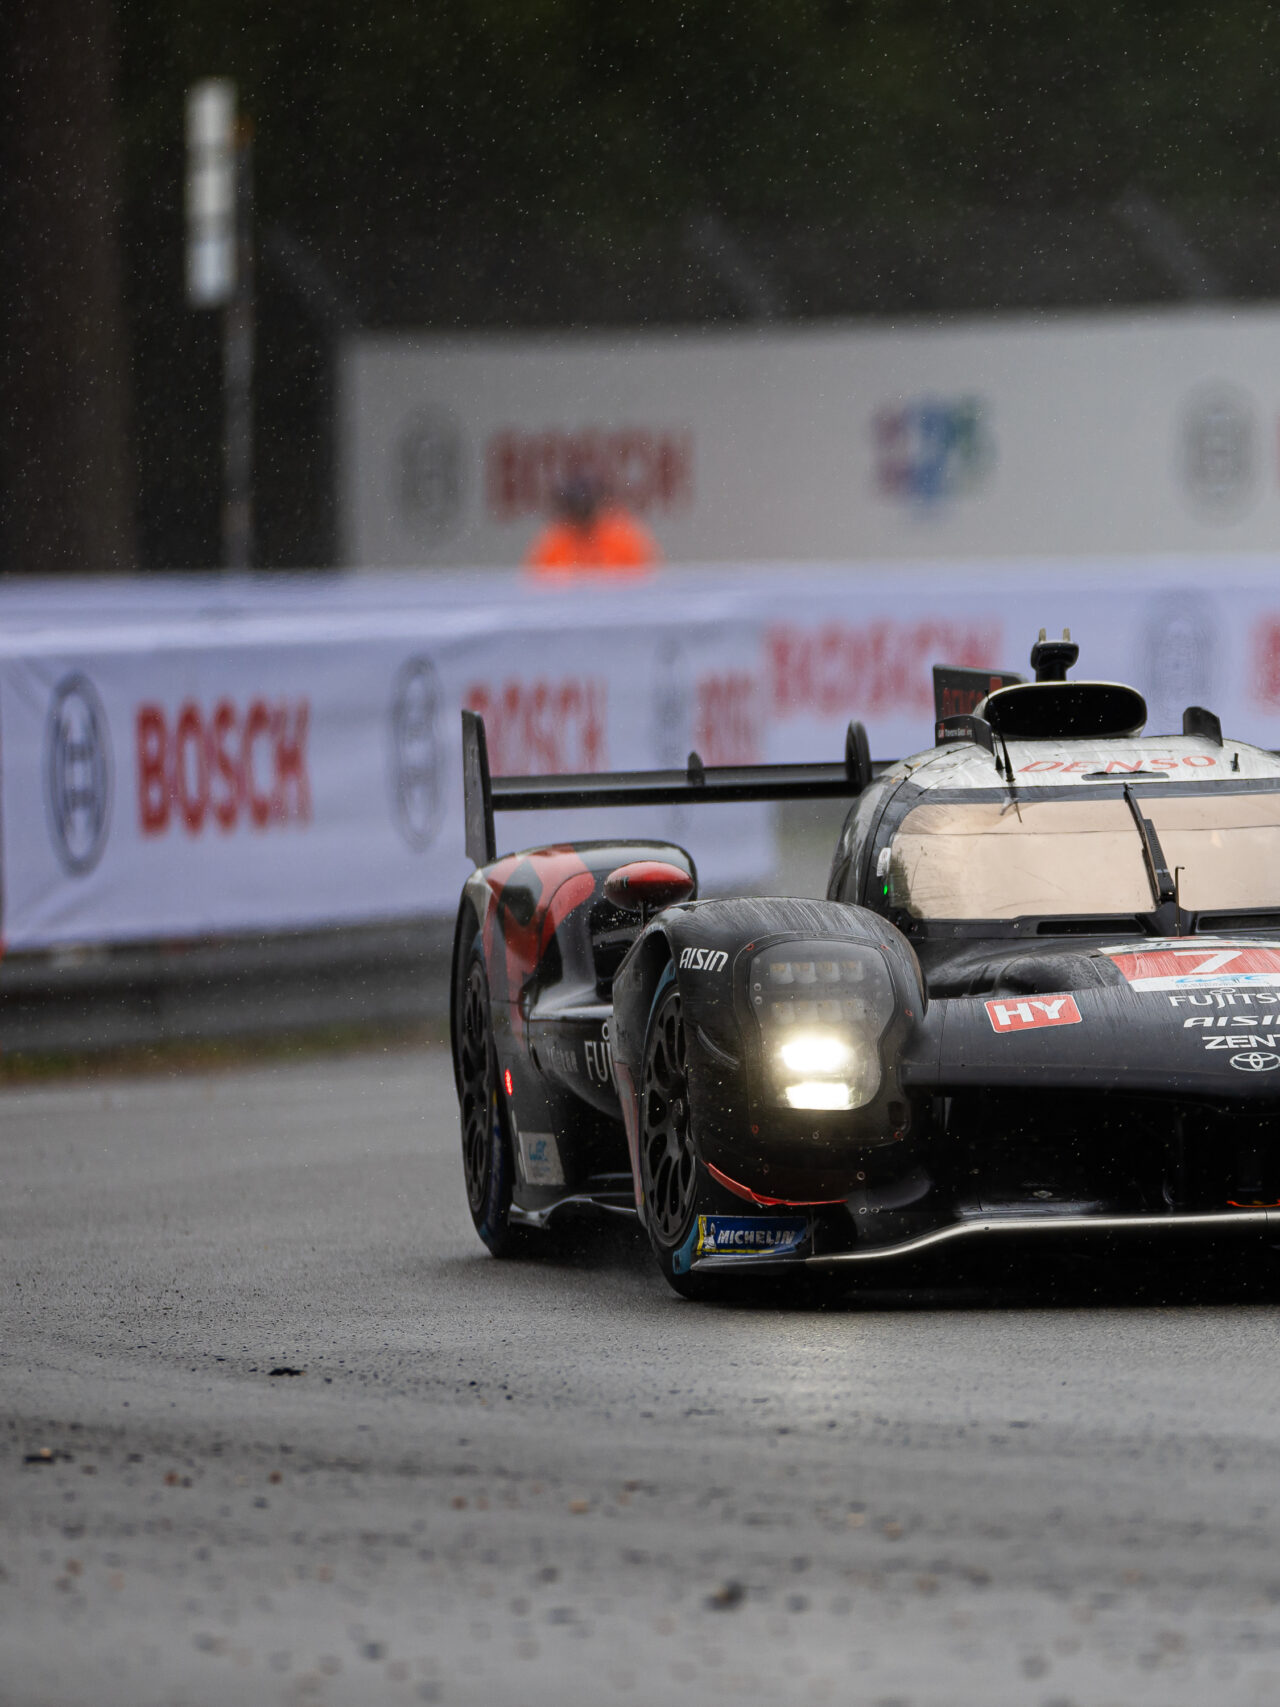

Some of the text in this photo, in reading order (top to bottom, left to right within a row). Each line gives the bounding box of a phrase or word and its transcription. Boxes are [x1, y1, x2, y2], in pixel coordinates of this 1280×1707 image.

[135, 699, 310, 837] BOSCH
[1017, 755, 1217, 773] DENSO
[680, 947, 728, 972] AISIN
[1173, 950, 1243, 974] 7
[993, 998, 1067, 1026] HY
[717, 1229, 797, 1245] MICHELIN
